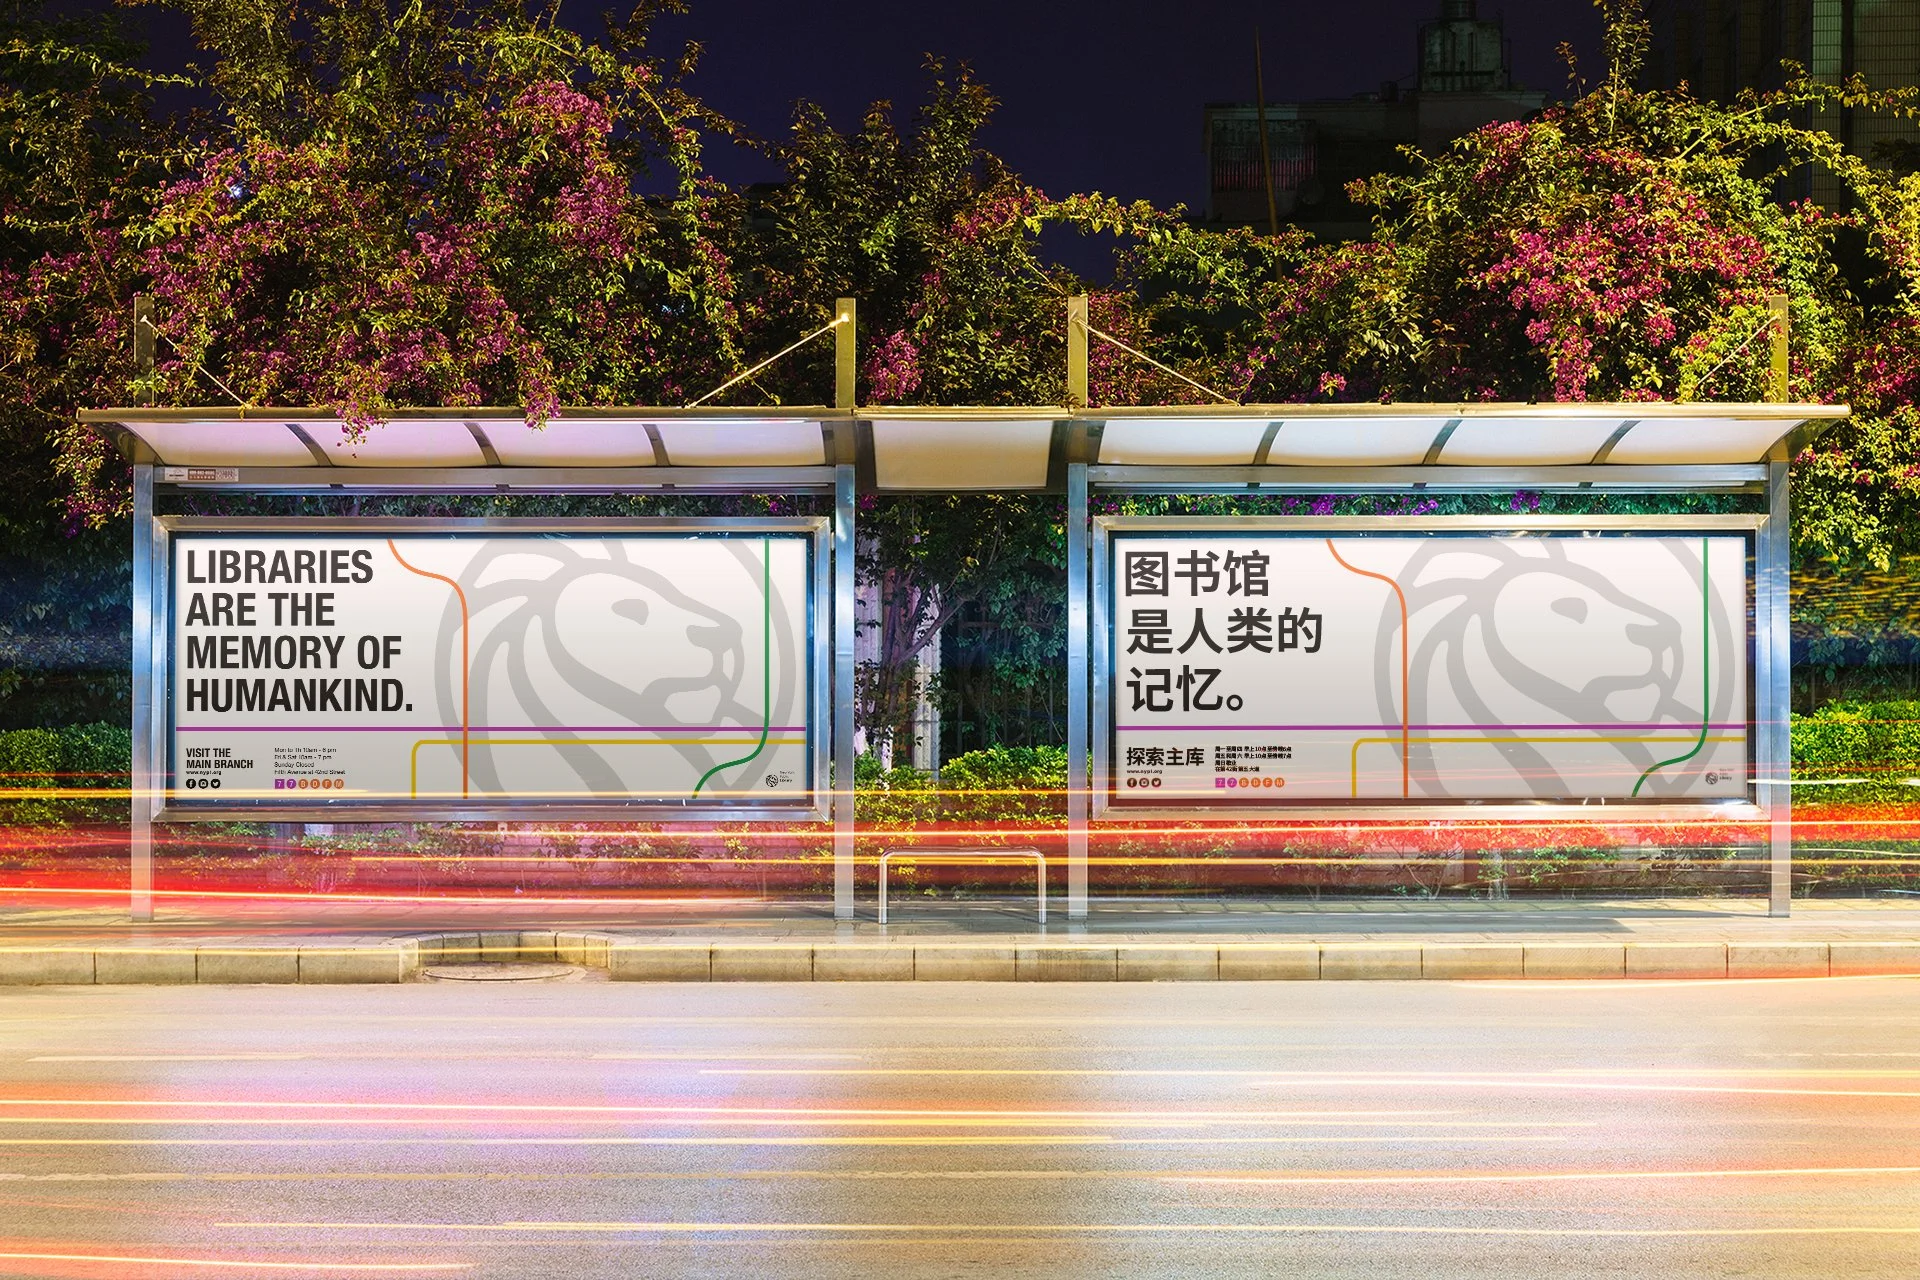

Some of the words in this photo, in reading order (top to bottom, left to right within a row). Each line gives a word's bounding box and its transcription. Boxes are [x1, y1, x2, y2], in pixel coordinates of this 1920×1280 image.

[187, 549, 374, 584] LIBRARIES
[1125, 549, 1270, 597] 图书馆
[185, 592, 257, 627] ARE
[267, 592, 336, 627] THE
[1126, 606, 1323, 655] 是人类的
[187, 635, 346, 670] MEMORY
[357, 635, 402, 670] OF
[186, 678, 413, 713] HUMANKIND.
[1126, 664, 1244, 713] 记忆。
[186, 747, 211, 758] VISIT
[213, 747, 232, 758] THE
[186, 759, 212, 769] MAIN
[214, 759, 254, 769] BRANCH
[1126, 746, 1205, 766] 探索主库
